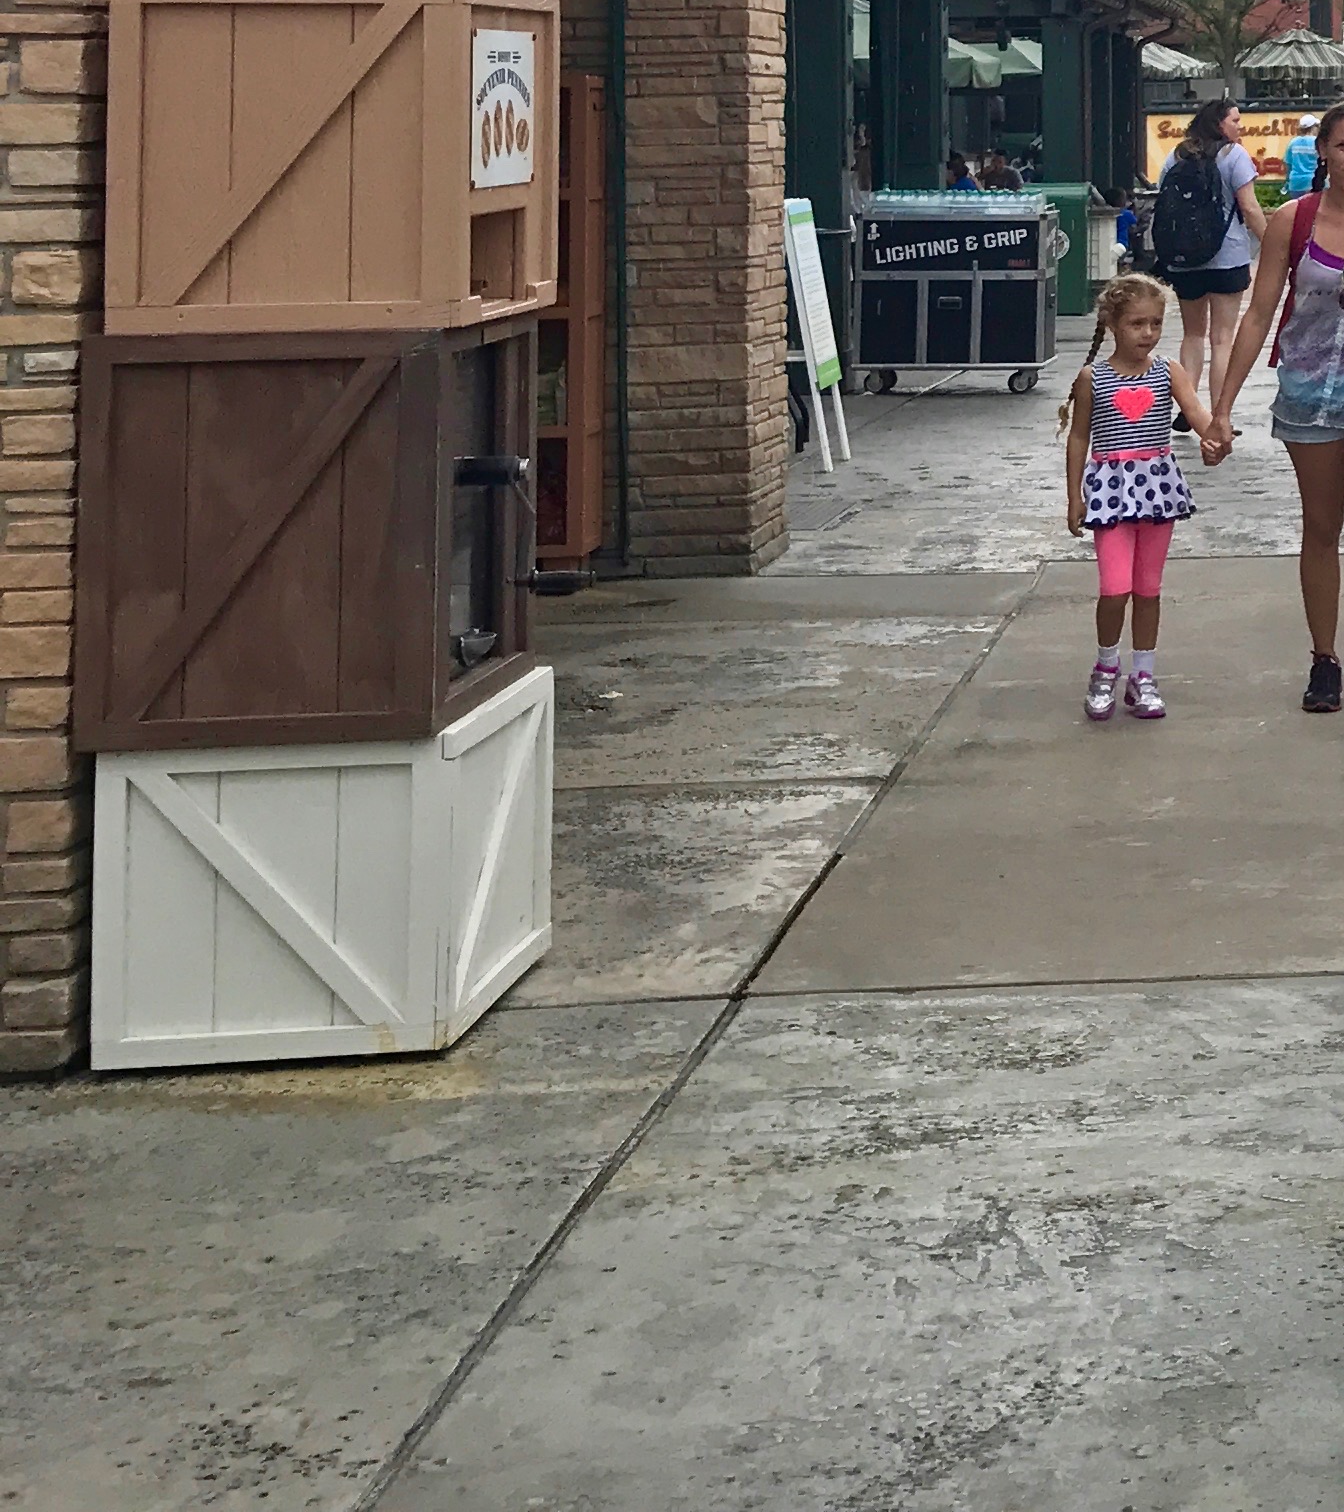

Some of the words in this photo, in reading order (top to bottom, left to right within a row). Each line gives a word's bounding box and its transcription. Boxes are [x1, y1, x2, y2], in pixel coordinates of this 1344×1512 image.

[1238, 118, 1282, 138] anch
[867, 233, 880, 241] UP
[874, 238, 960, 265] LIGHTING
[965, 235, 979, 252] &
[982, 228, 1028, 250] GRIP
